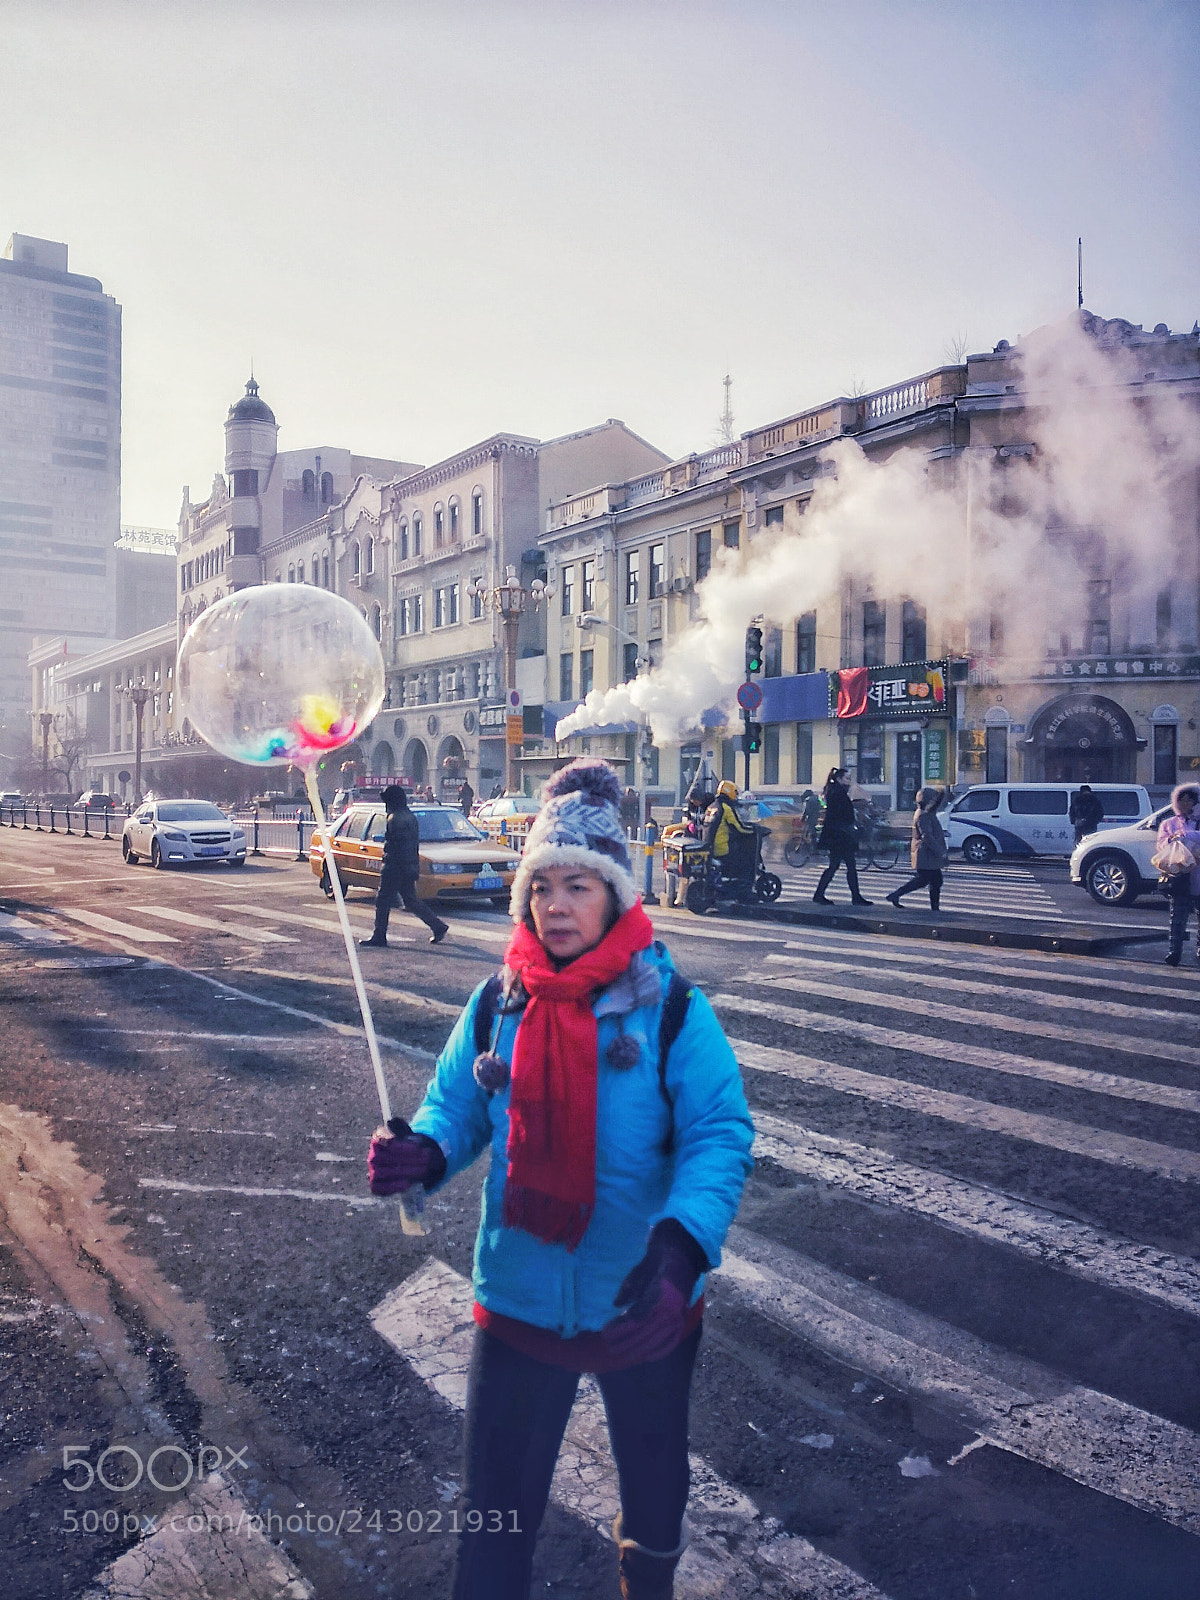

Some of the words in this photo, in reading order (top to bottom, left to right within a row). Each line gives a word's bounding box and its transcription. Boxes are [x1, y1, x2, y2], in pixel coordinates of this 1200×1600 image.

[122, 528, 177, 547] 林苑宾馆
[1031, 829, 1075, 840] 行政执
